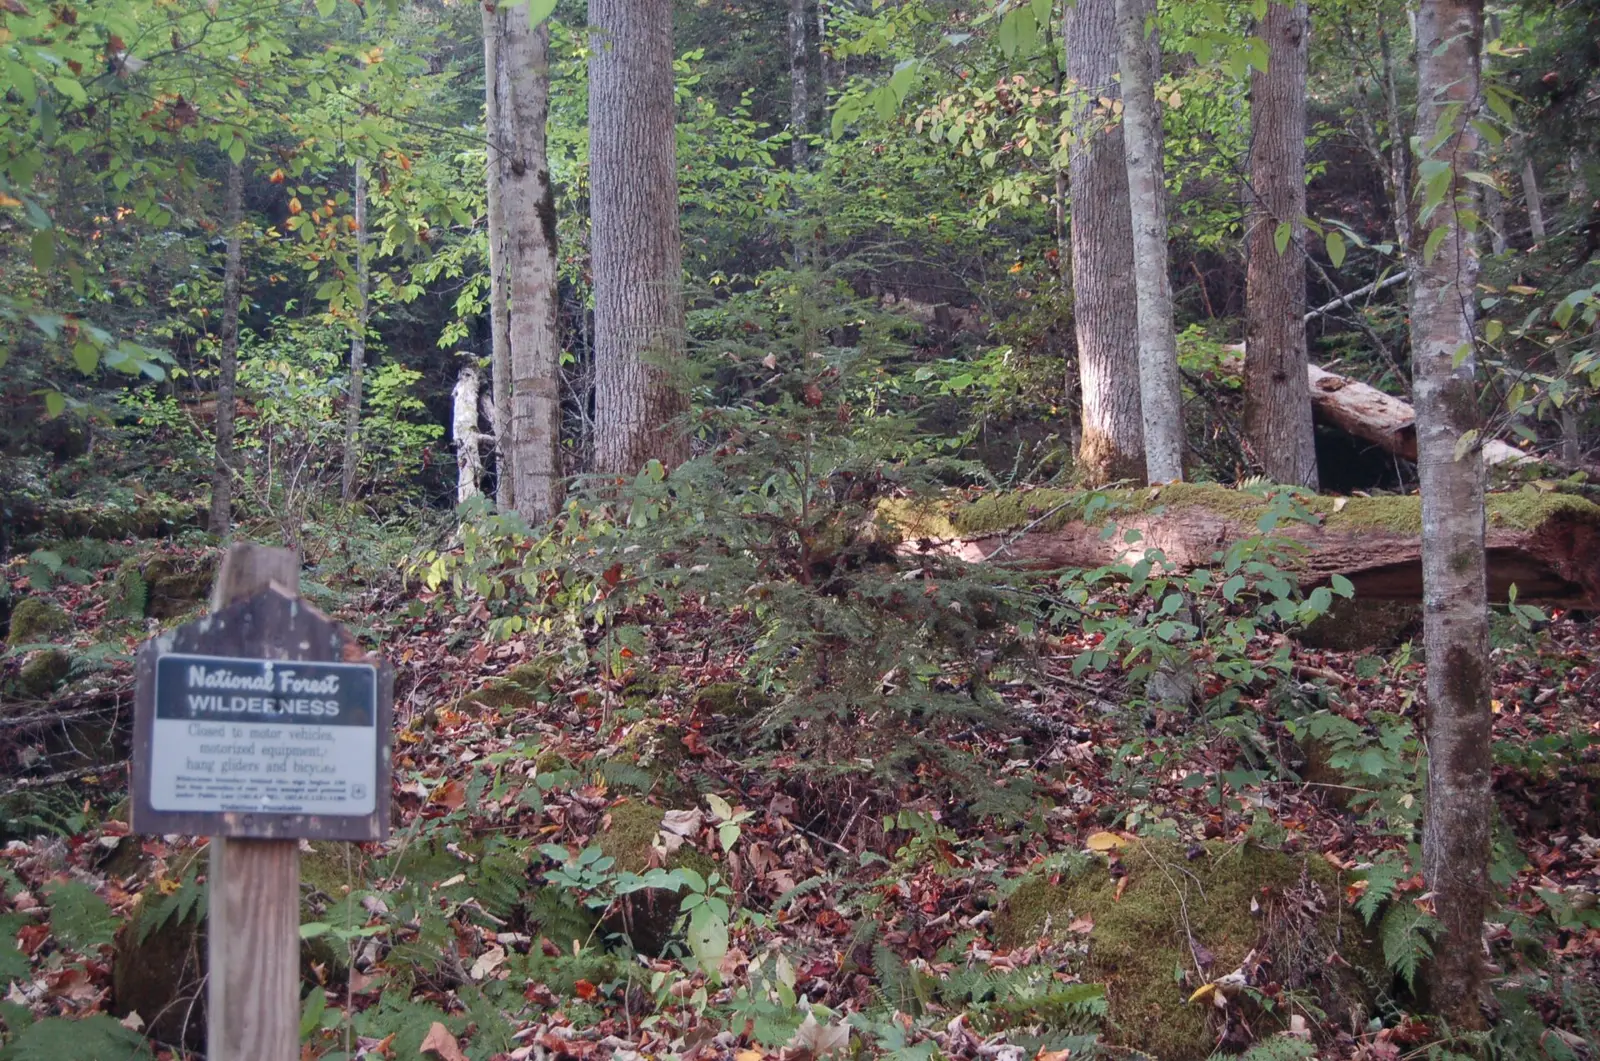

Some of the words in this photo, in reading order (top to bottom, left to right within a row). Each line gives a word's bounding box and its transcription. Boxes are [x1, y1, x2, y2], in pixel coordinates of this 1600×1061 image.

[188, 665, 274, 692] National
[279, 670, 339, 694] Forest
[188, 695, 340, 716] WILDERNESS
[188, 723, 225, 737] Closed
[232, 727, 243, 738] to
[250, 728, 282, 740] motor
[200, 742, 255, 756] motorized
[187, 757, 215, 773] hang
[221, 758, 260, 774] gliders
[266, 760, 286, 774] and
